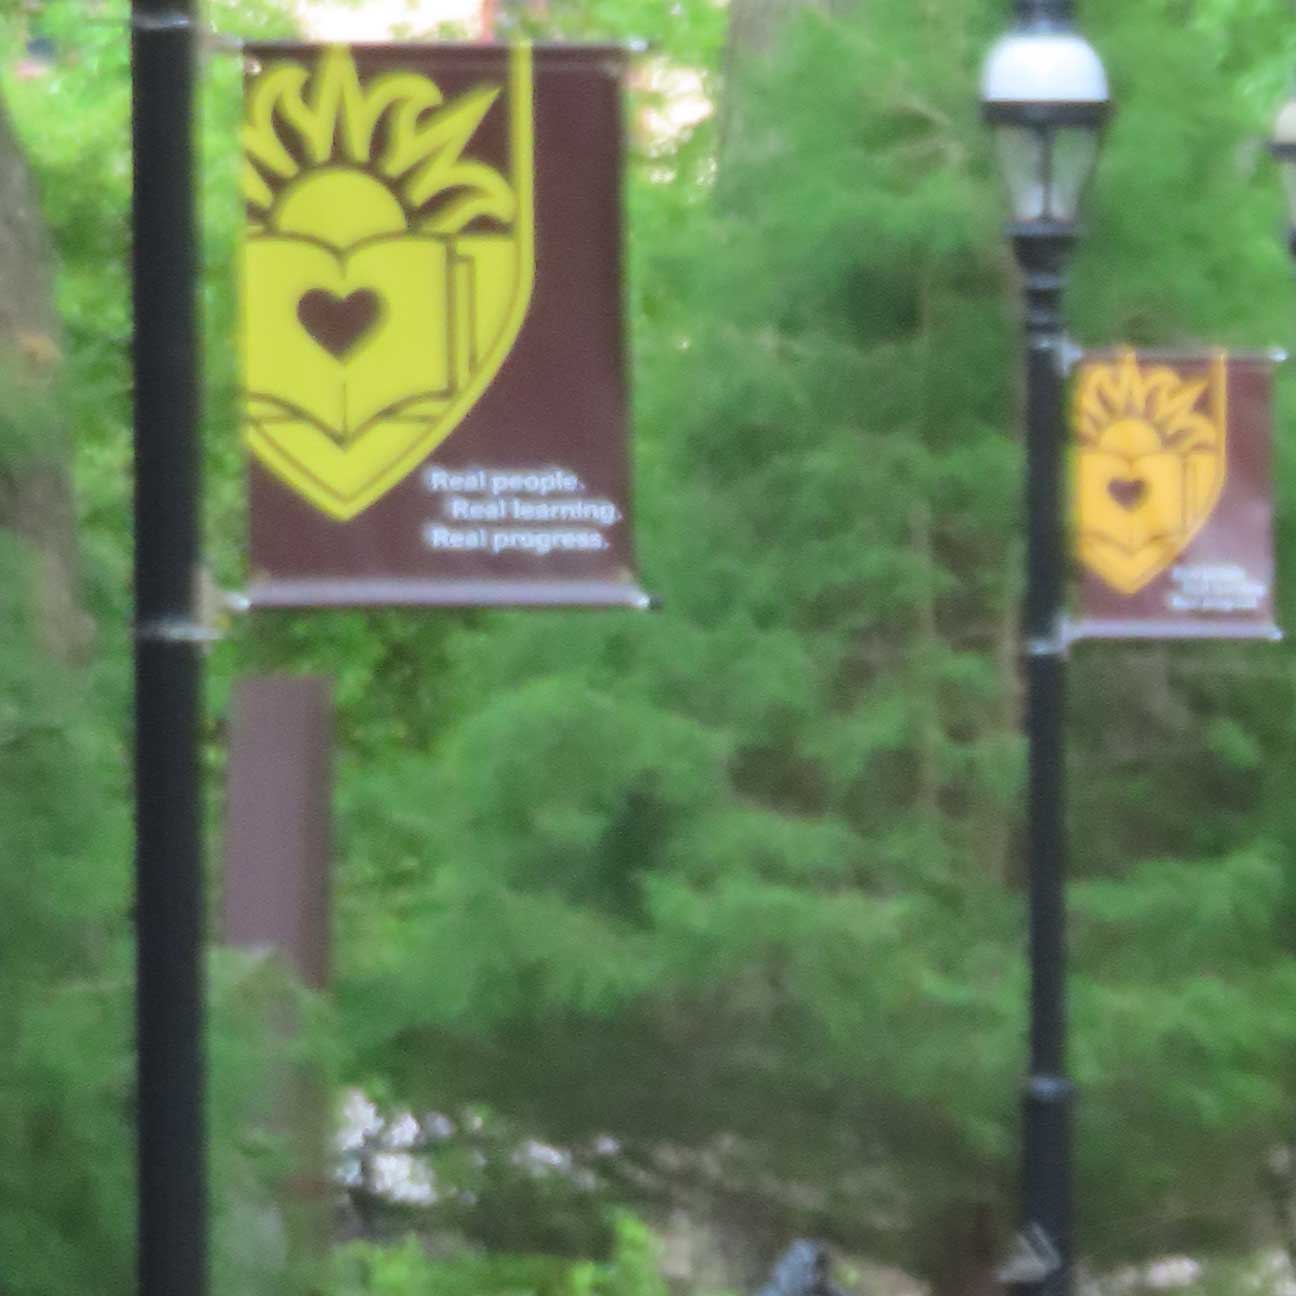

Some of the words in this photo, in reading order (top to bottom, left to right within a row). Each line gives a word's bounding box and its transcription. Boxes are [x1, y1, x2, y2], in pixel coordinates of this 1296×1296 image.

[427, 468, 487, 491] Real
[491, 469, 585, 496] people.
[450, 499, 506, 520] Real
[510, 499, 623, 528] learning.
[427, 526, 487, 549] Real
[492, 528, 610, 555] progress.
